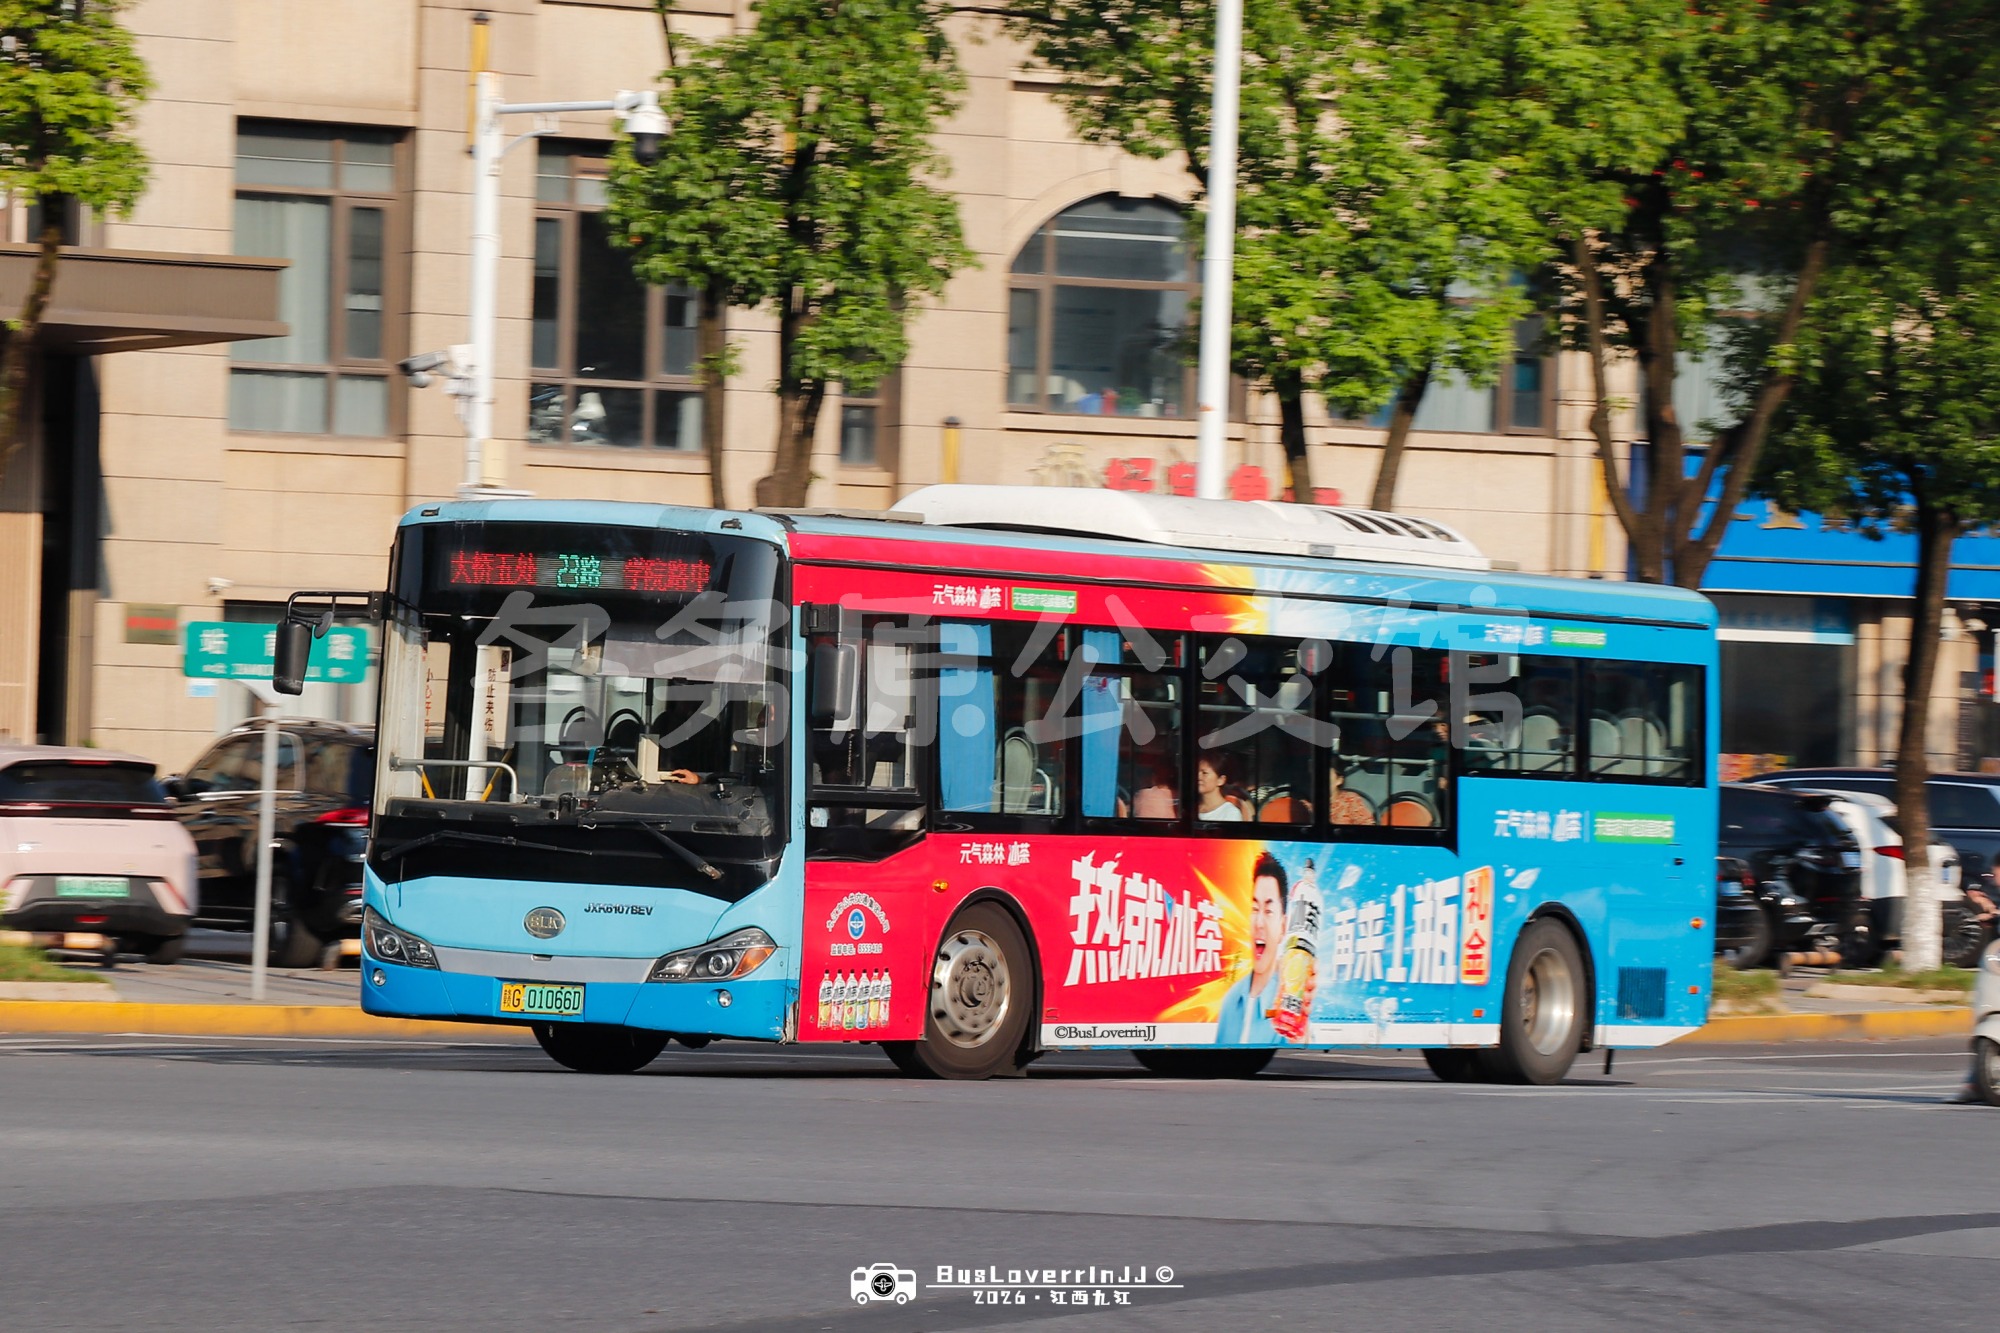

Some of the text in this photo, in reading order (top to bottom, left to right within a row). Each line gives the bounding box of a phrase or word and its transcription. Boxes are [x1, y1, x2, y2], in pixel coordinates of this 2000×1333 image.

[451, 550, 537, 585] 大桥五处
[624, 557, 711, 592] 学院路中
[484, 668, 497, 731] 防止夹伤
[960, 842, 1005, 865] 元气森林
[584, 903, 653, 916] JXK6107BEV
[1063, 850, 1223, 987] 热就冰茶
[1332, 876, 1461, 984] 再来1瓶
